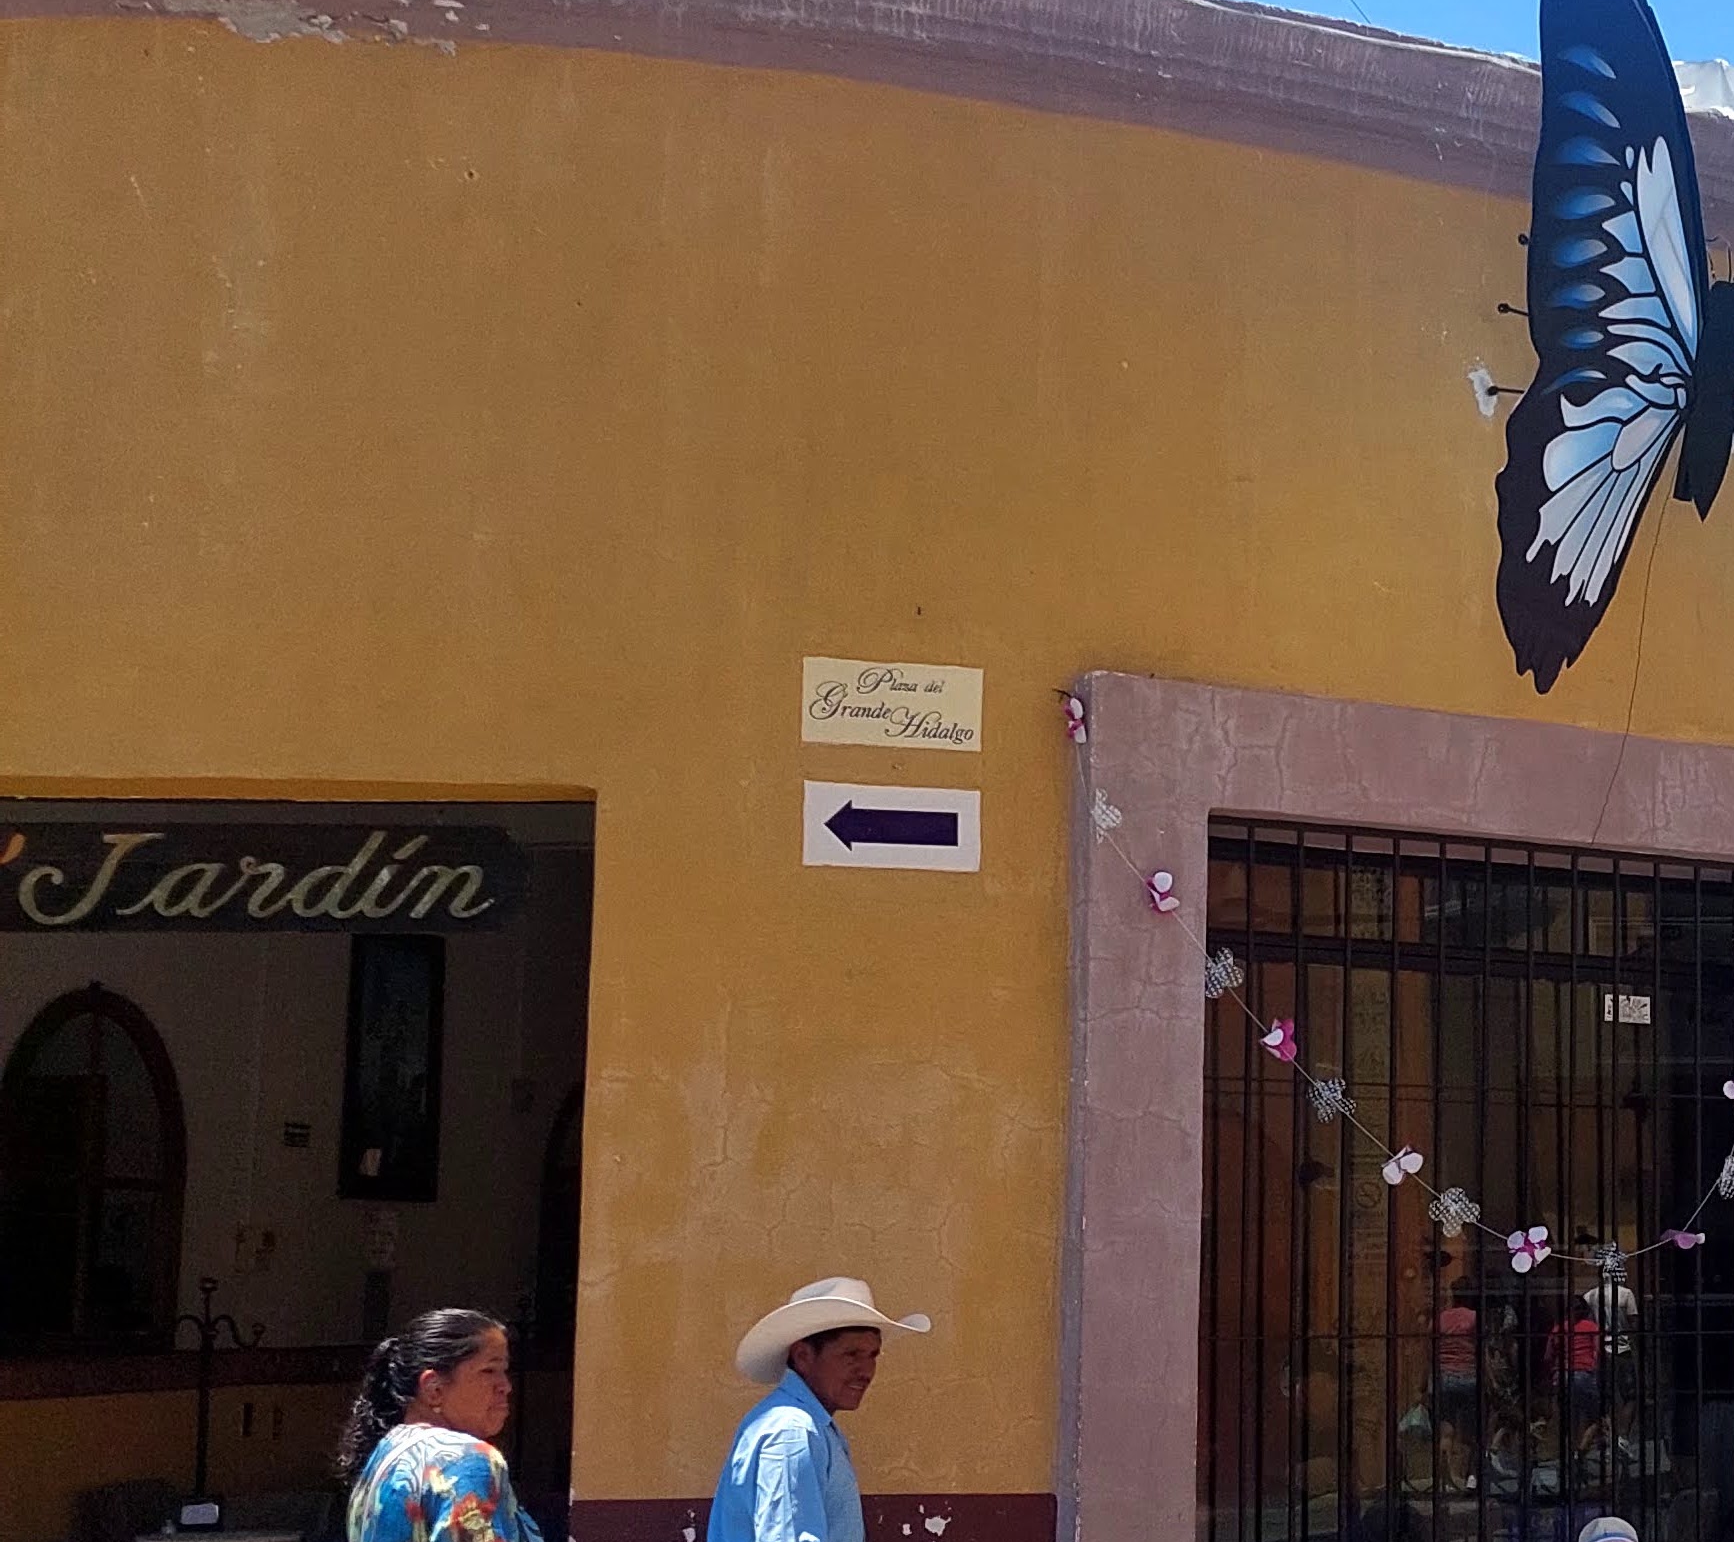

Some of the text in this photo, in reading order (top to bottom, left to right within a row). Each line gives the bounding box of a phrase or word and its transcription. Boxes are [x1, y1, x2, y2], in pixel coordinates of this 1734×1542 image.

[857, 667, 944, 694] Plaza del
[809, 681, 891, 720] Grande
[885, 707, 974, 744] Hidalgo
[18, 830, 495, 925] Jardín
